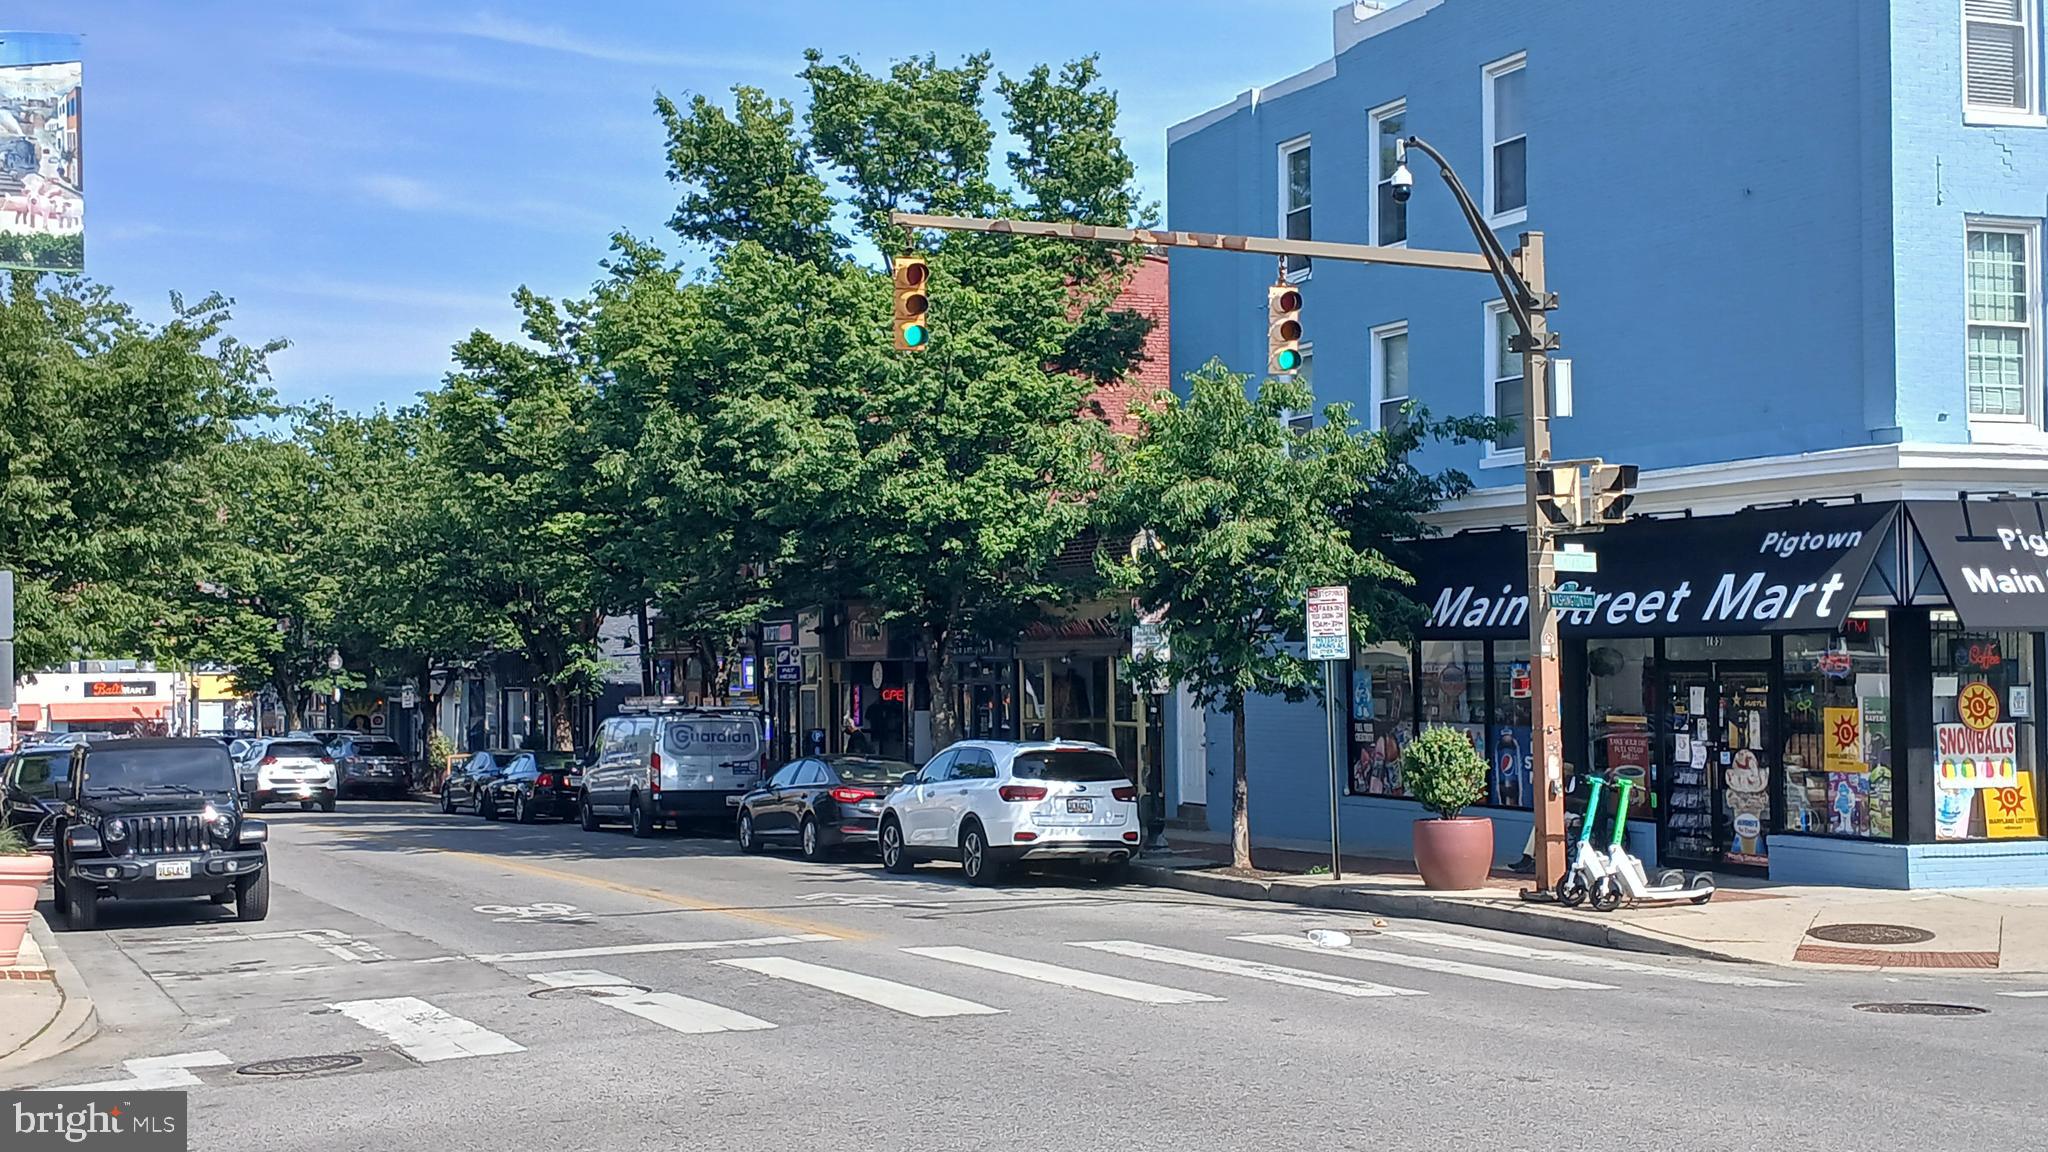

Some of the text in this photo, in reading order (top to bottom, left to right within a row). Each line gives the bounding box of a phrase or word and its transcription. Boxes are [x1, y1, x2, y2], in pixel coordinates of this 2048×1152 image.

[1760, 529, 1863, 558] Pigtown
[1997, 528, 2048, 557] Pig
[1961, 567, 2046, 593] Main
[1424, 583, 1530, 627] Main
[1702, 571, 1844, 622] Mart
[1969, 644, 2000, 670] Coffee
[1939, 726, 2014, 756] SNOWBALLS
